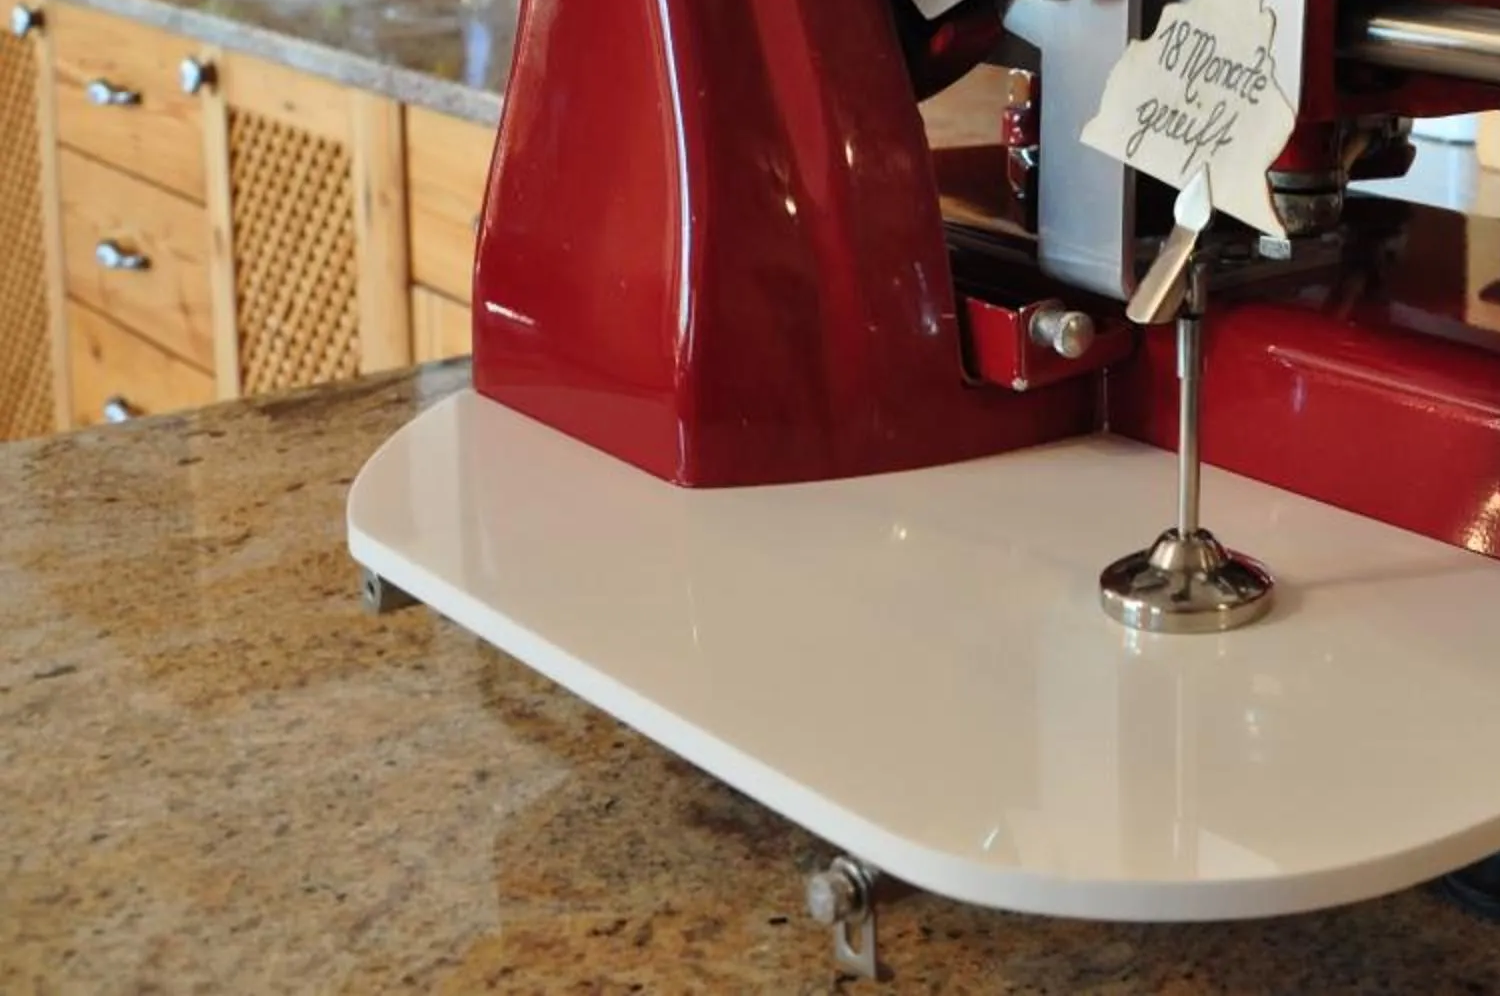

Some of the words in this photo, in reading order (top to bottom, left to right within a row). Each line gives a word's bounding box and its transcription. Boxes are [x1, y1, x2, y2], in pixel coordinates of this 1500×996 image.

[1158, 20, 1190, 72] 18
[1180, 28, 1267, 104] Monate
[1126, 99, 1239, 174] gereift
